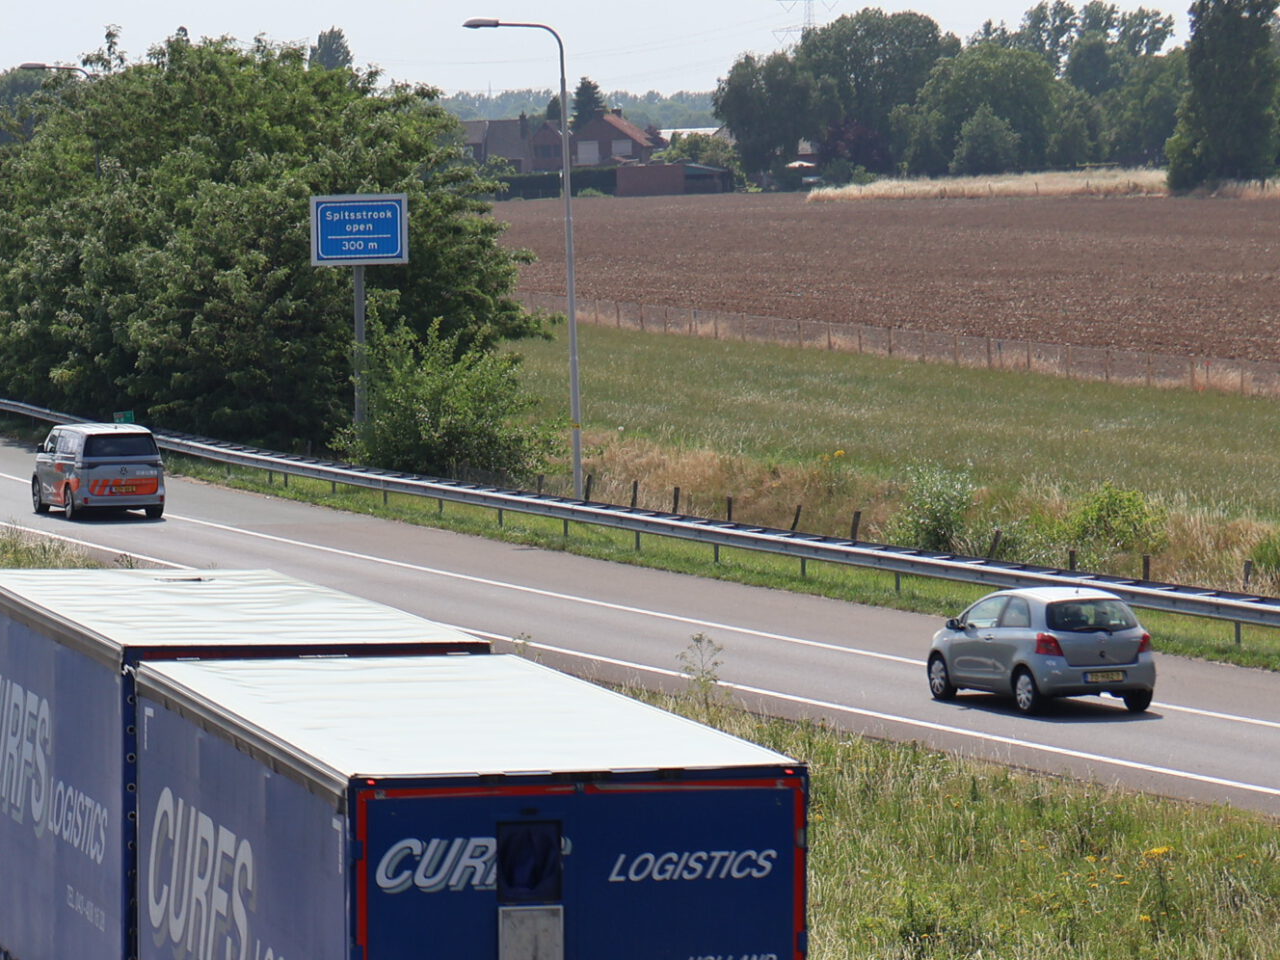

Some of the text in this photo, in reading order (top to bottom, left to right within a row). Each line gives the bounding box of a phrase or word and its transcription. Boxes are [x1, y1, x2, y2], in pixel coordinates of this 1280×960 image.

[326, 211, 392, 220] Spitsstrook
[346, 223, 373, 232] open
[342, 241, 364, 250] 300
[47, 776, 108, 864] LOGISTICS
[608, 849, 777, 882] LOGISTICS
